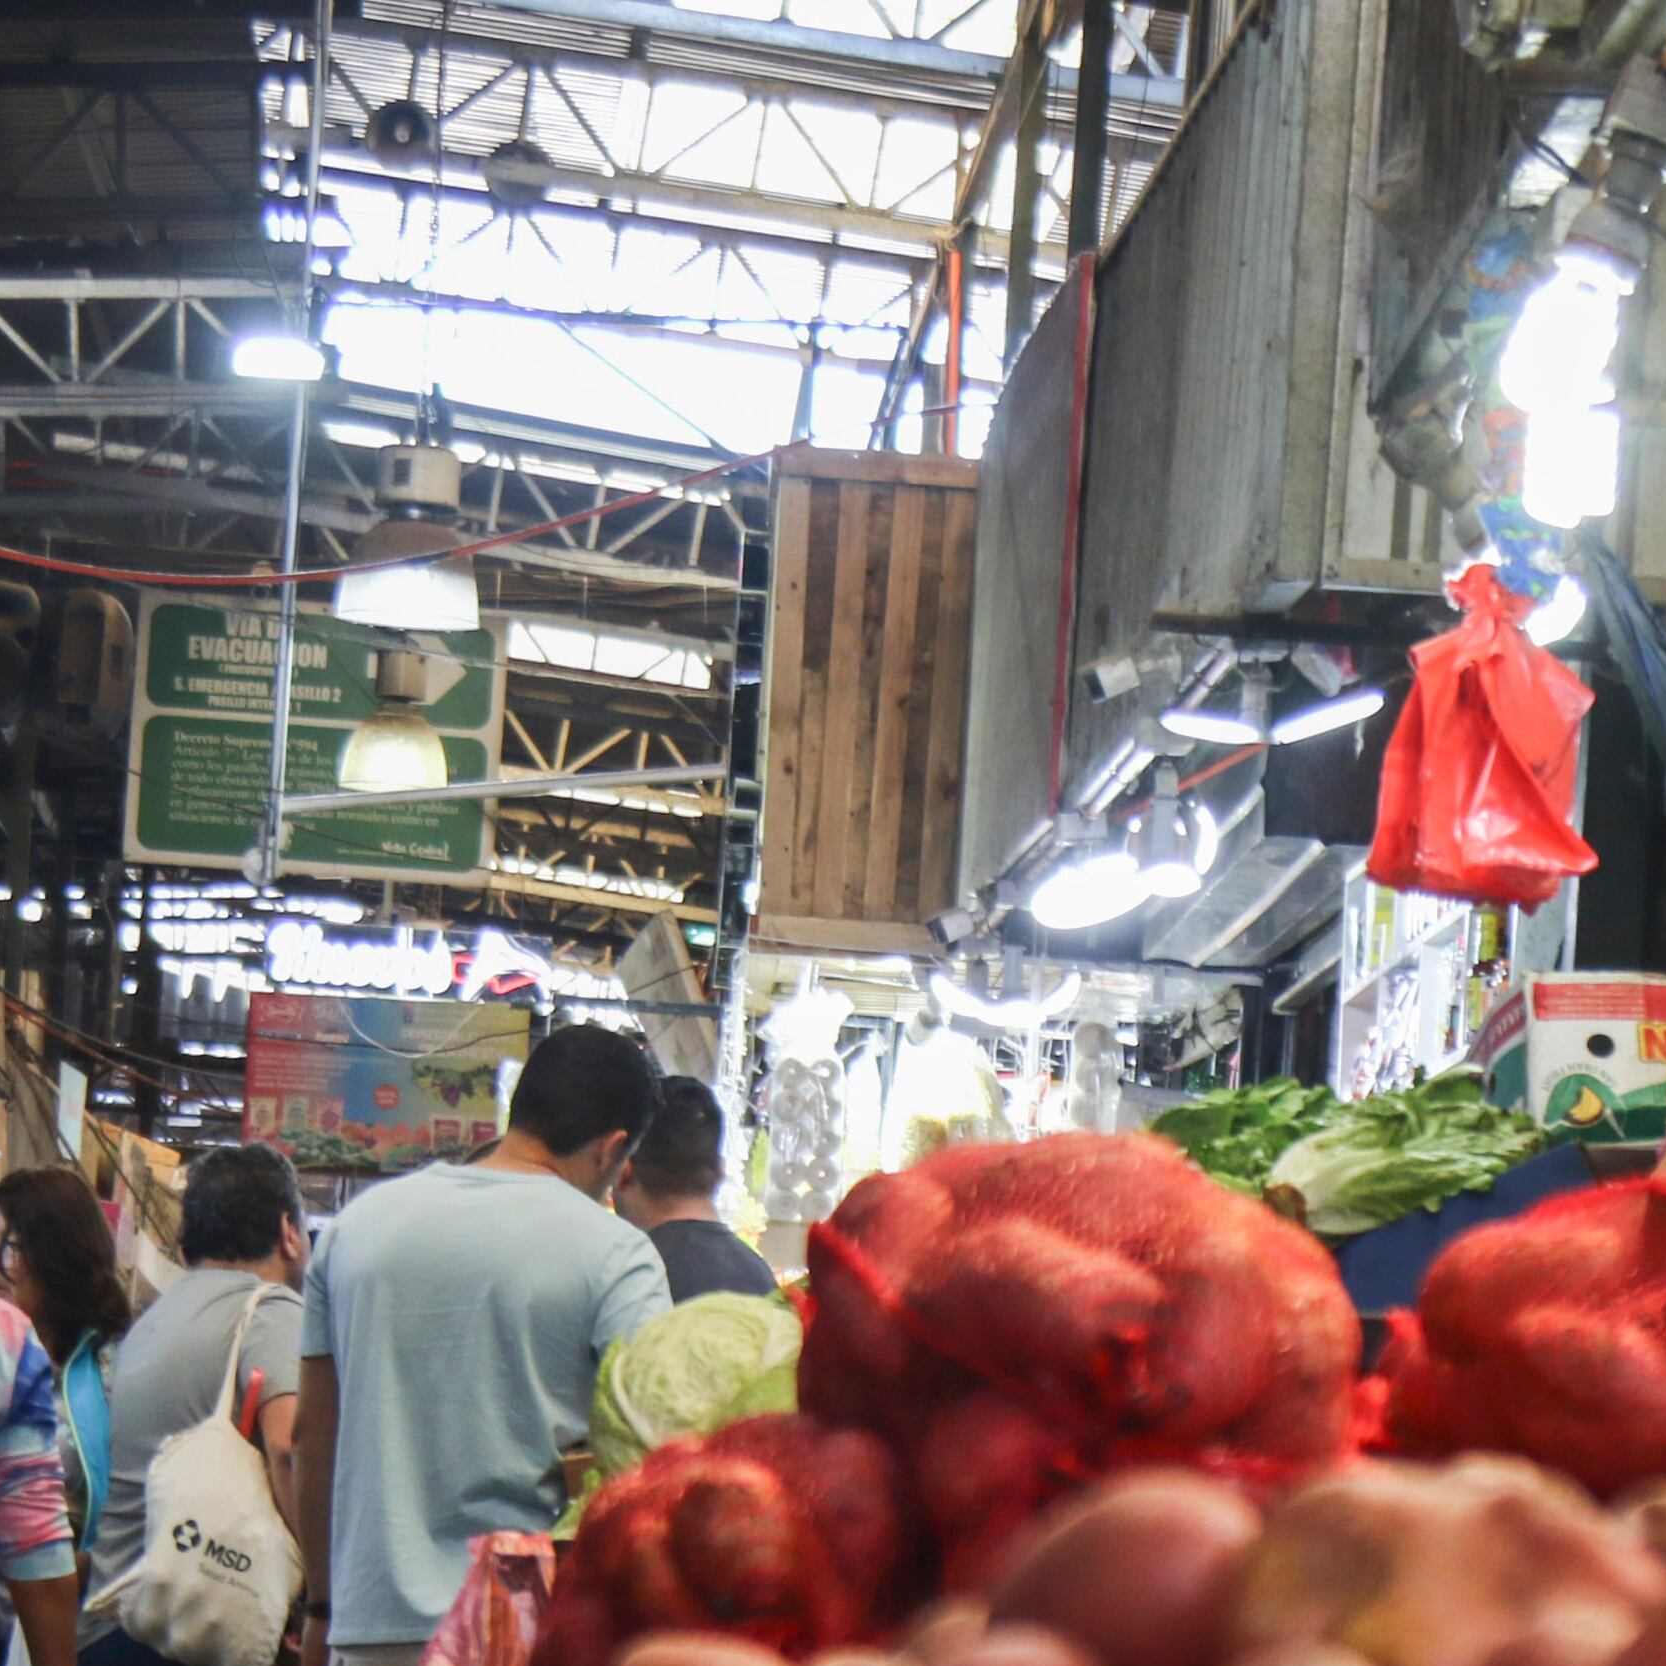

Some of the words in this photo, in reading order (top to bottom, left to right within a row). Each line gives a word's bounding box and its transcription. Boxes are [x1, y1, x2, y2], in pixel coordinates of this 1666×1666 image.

[188, 635, 328, 669] EVACUAION
[188, 677, 269, 697] EMERGENCIA
[288, 684, 331, 702] ASILLO
[332, 688, 343, 703] 2
[224, 734, 275, 750] Suprem
[204, 1539, 252, 1573] MSD
